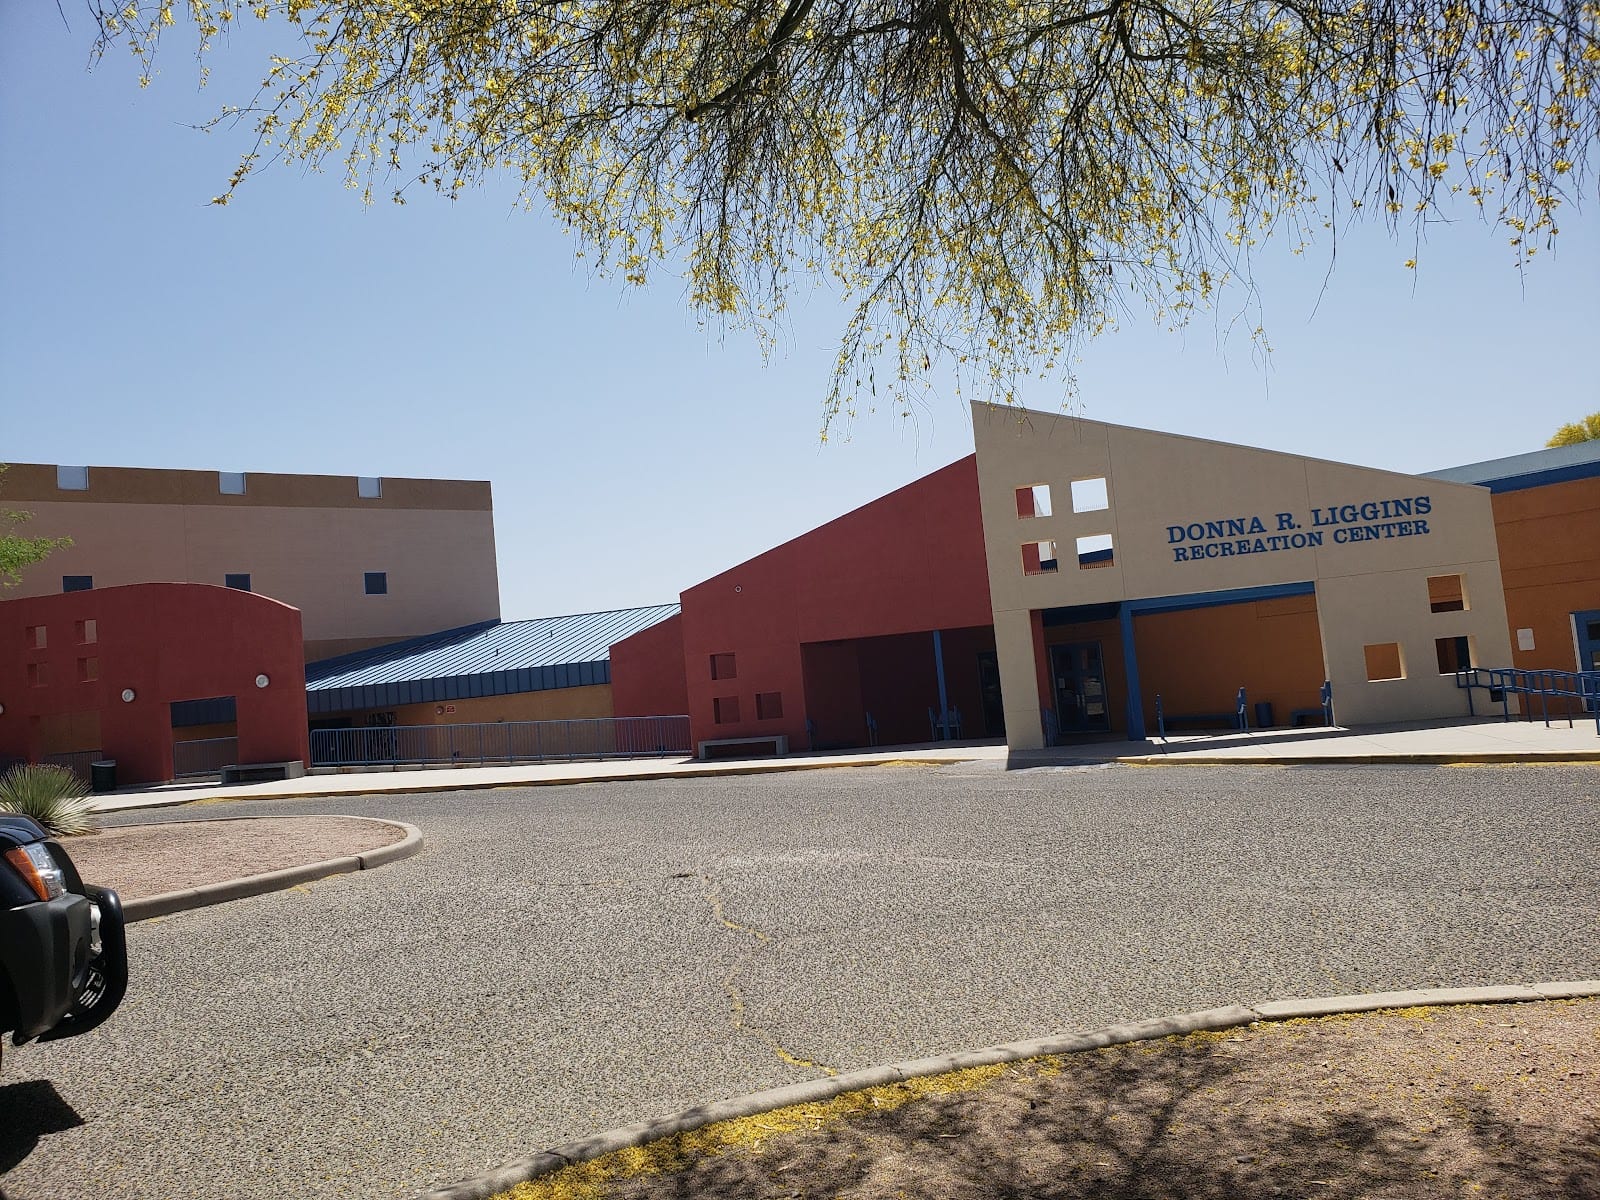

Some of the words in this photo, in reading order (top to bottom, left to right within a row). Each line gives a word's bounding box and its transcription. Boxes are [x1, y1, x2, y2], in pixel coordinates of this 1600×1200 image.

[1166, 516, 1267, 544] DONNA
[1275, 512, 1301, 531] R.
[1311, 496, 1432, 527] LIGGINS
[1173, 532, 1324, 562] RECREATION
[1333, 519, 1430, 544] CENTER
